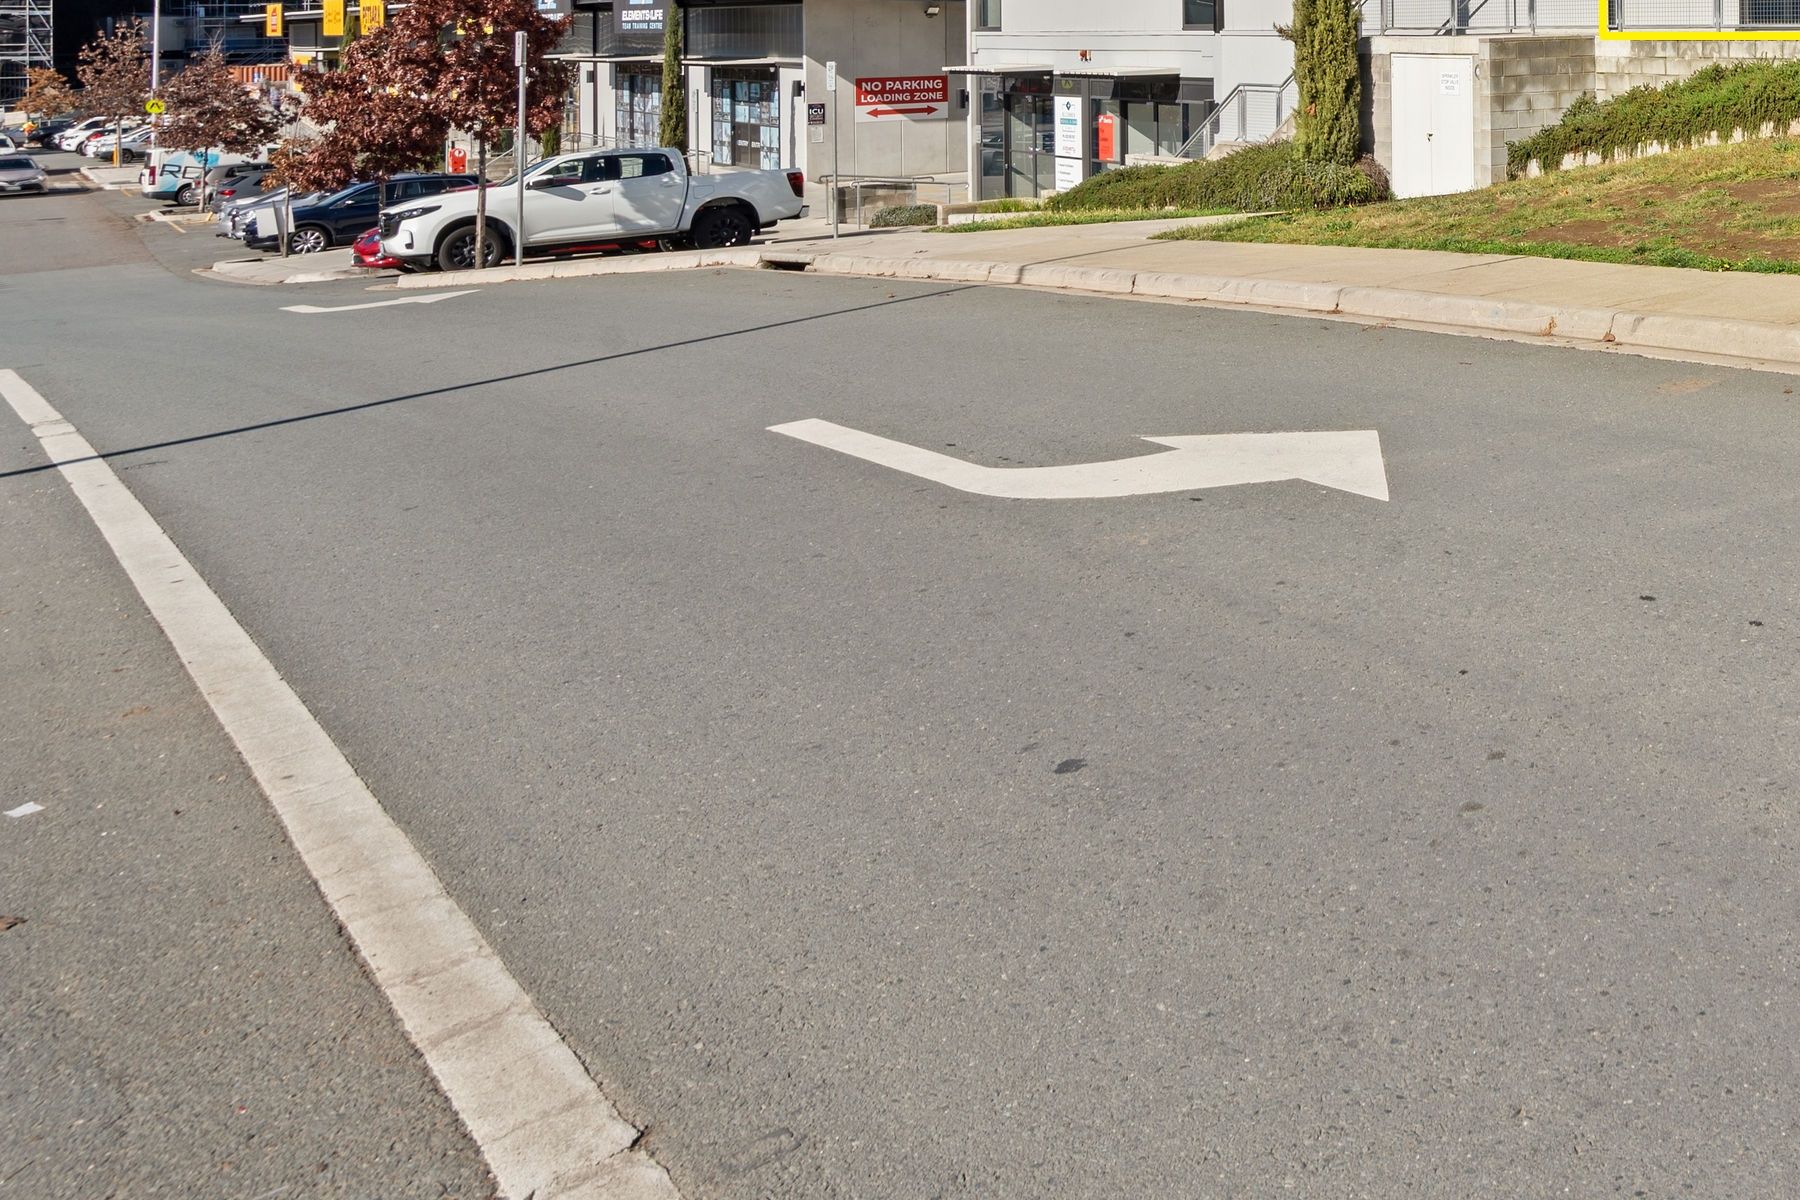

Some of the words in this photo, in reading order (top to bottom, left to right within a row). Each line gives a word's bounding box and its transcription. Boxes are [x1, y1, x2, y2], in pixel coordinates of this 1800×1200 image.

[861, 81, 882, 92] NO
[885, 79, 943, 91] PARKING
[860, 92, 911, 103] LOADING
[913, 91, 944, 101] ZONE
